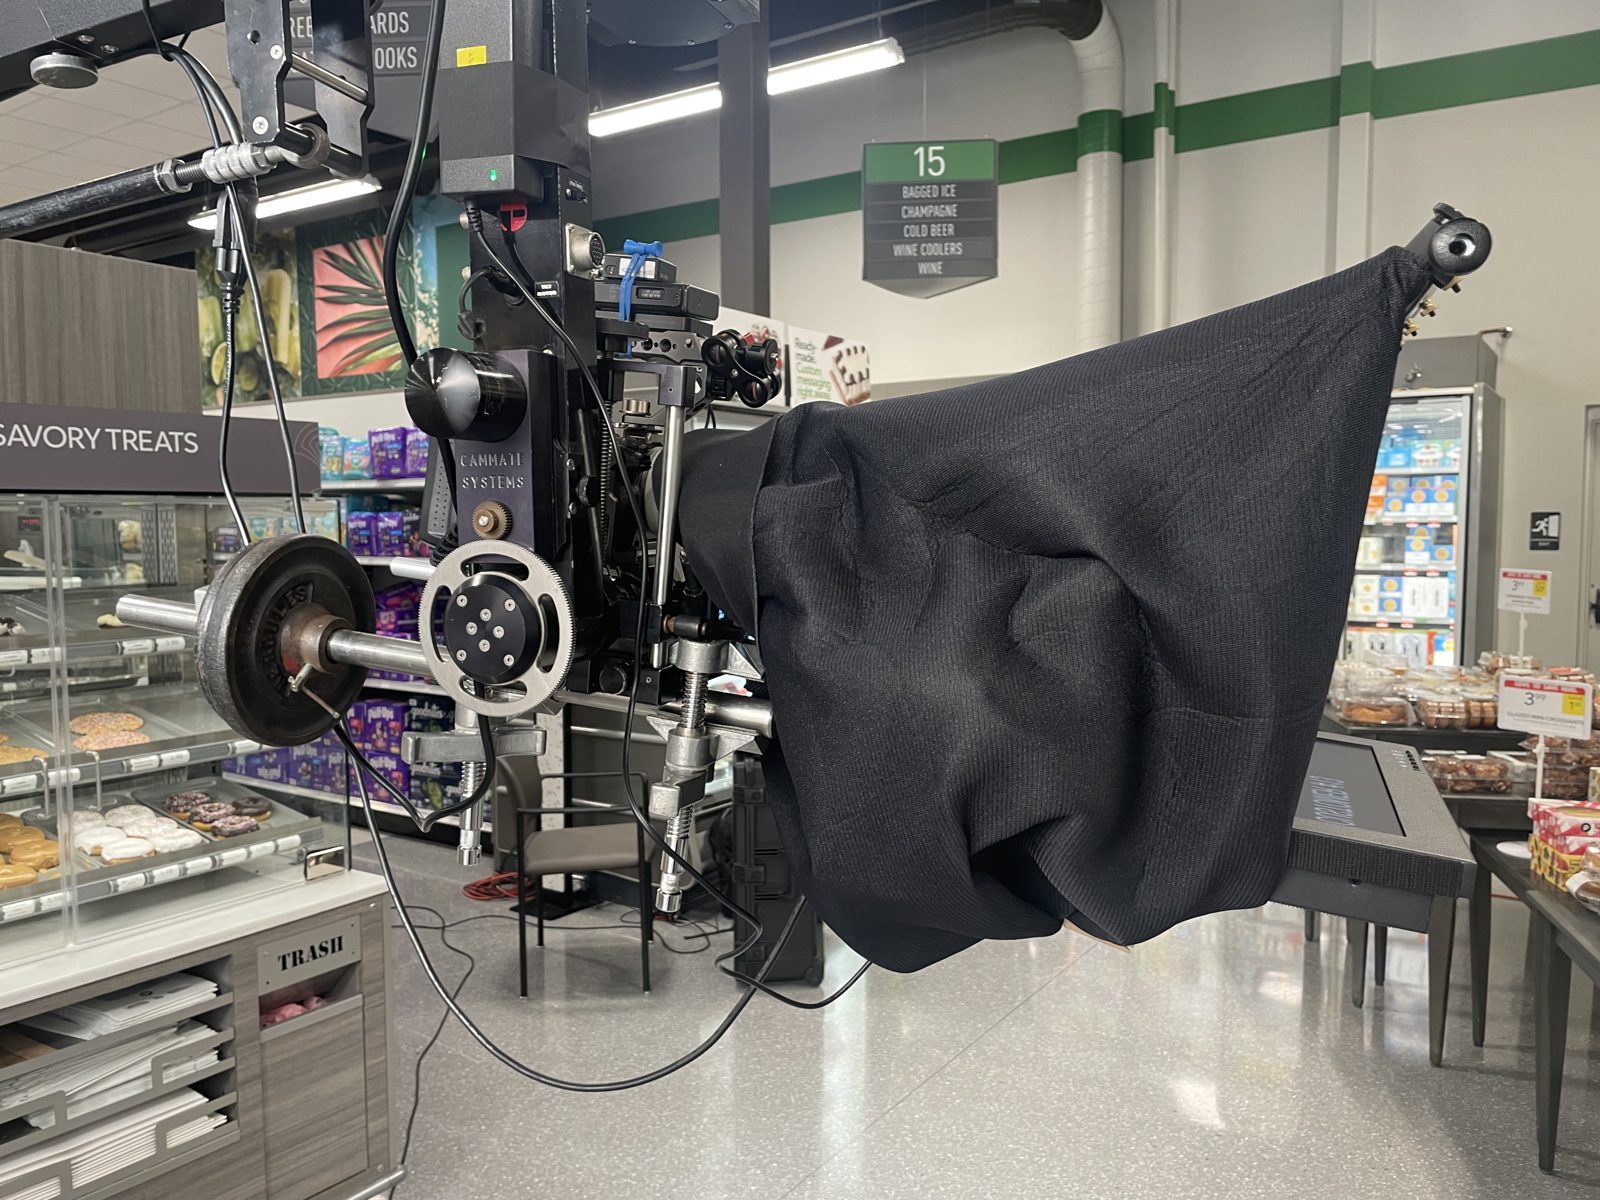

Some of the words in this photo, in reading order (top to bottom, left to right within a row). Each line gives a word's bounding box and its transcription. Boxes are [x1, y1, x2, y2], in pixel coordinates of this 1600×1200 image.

[370, 12, 409, 34] ARDS
[374, 46, 418, 69] OOKS
[913, 145, 946, 177] 15
[902, 185, 939, 199] BAGGED
[941, 184, 957, 198] ICE
[901, 204, 958, 219] CHAMPAGNE
[903, 224, 928, 238] COLD
[930, 223, 955, 237] BEER
[893, 243, 918, 257] WINE
[920, 242, 963, 256] COOLERS
[918, 261, 943, 275] WINE
[0, 424, 101, 450] SAVORY
[105, 428, 199, 454] TREATS
[460, 452, 524, 467] CAMMATE
[462, 476, 524, 489] SYSTEMS
[277, 935, 344, 972] TRASH
